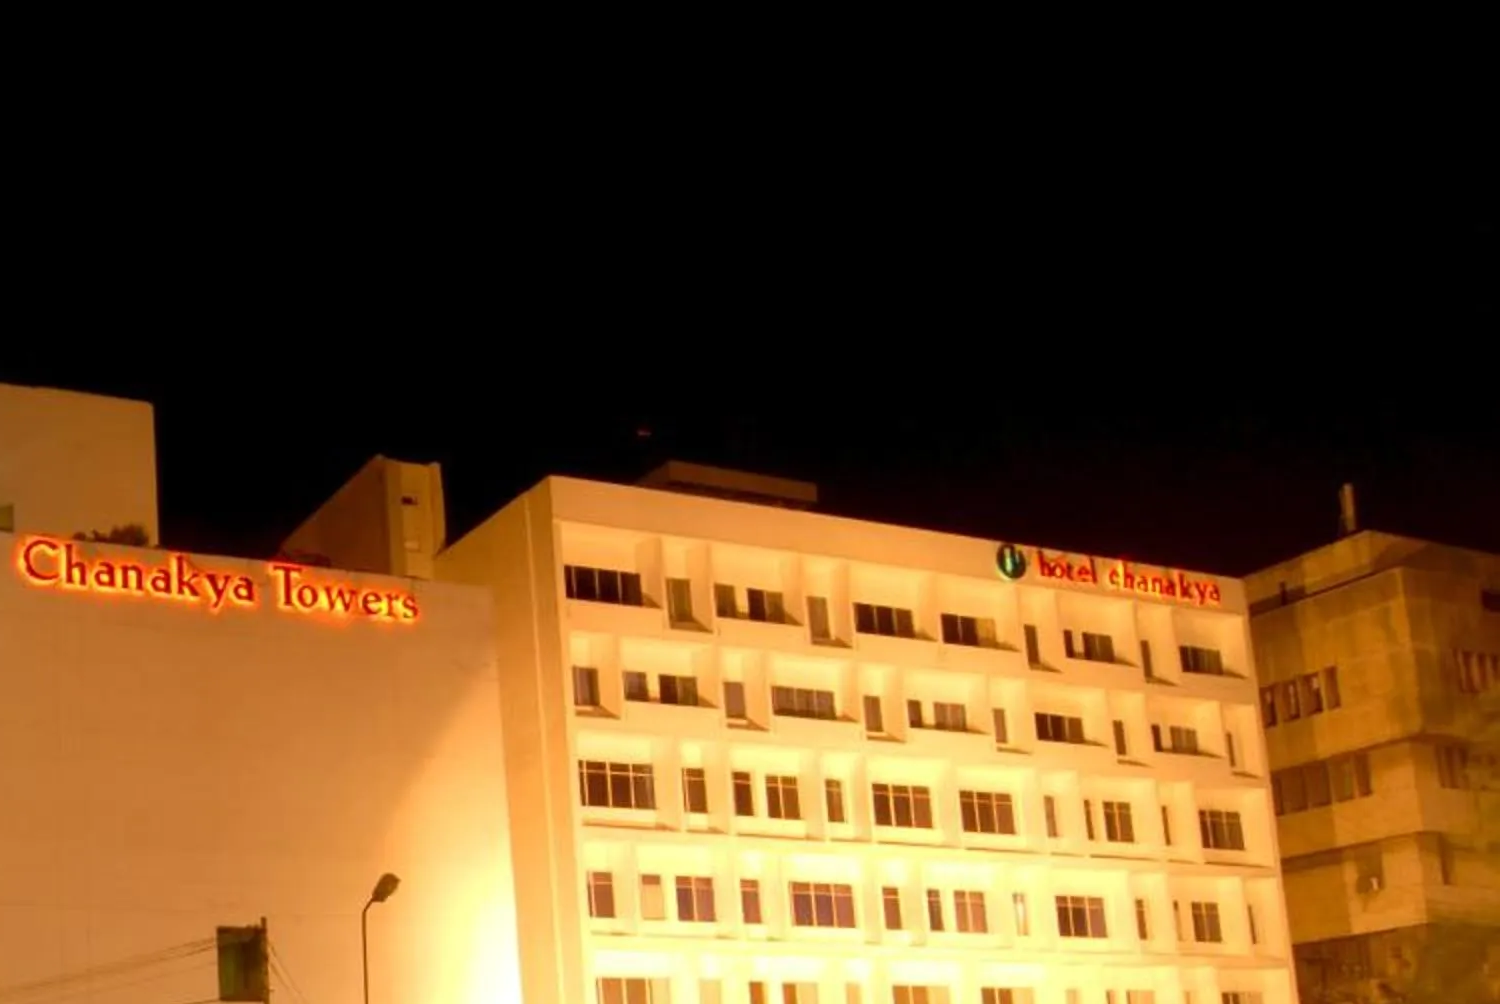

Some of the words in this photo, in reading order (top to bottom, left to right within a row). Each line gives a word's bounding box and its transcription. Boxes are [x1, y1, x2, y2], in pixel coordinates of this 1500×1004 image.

[22, 538, 254, 609] Chanakya
[272, 564, 419, 620] Towers
[1037, 549, 1098, 584] hotel
[1108, 557, 1222, 606] chanakya
